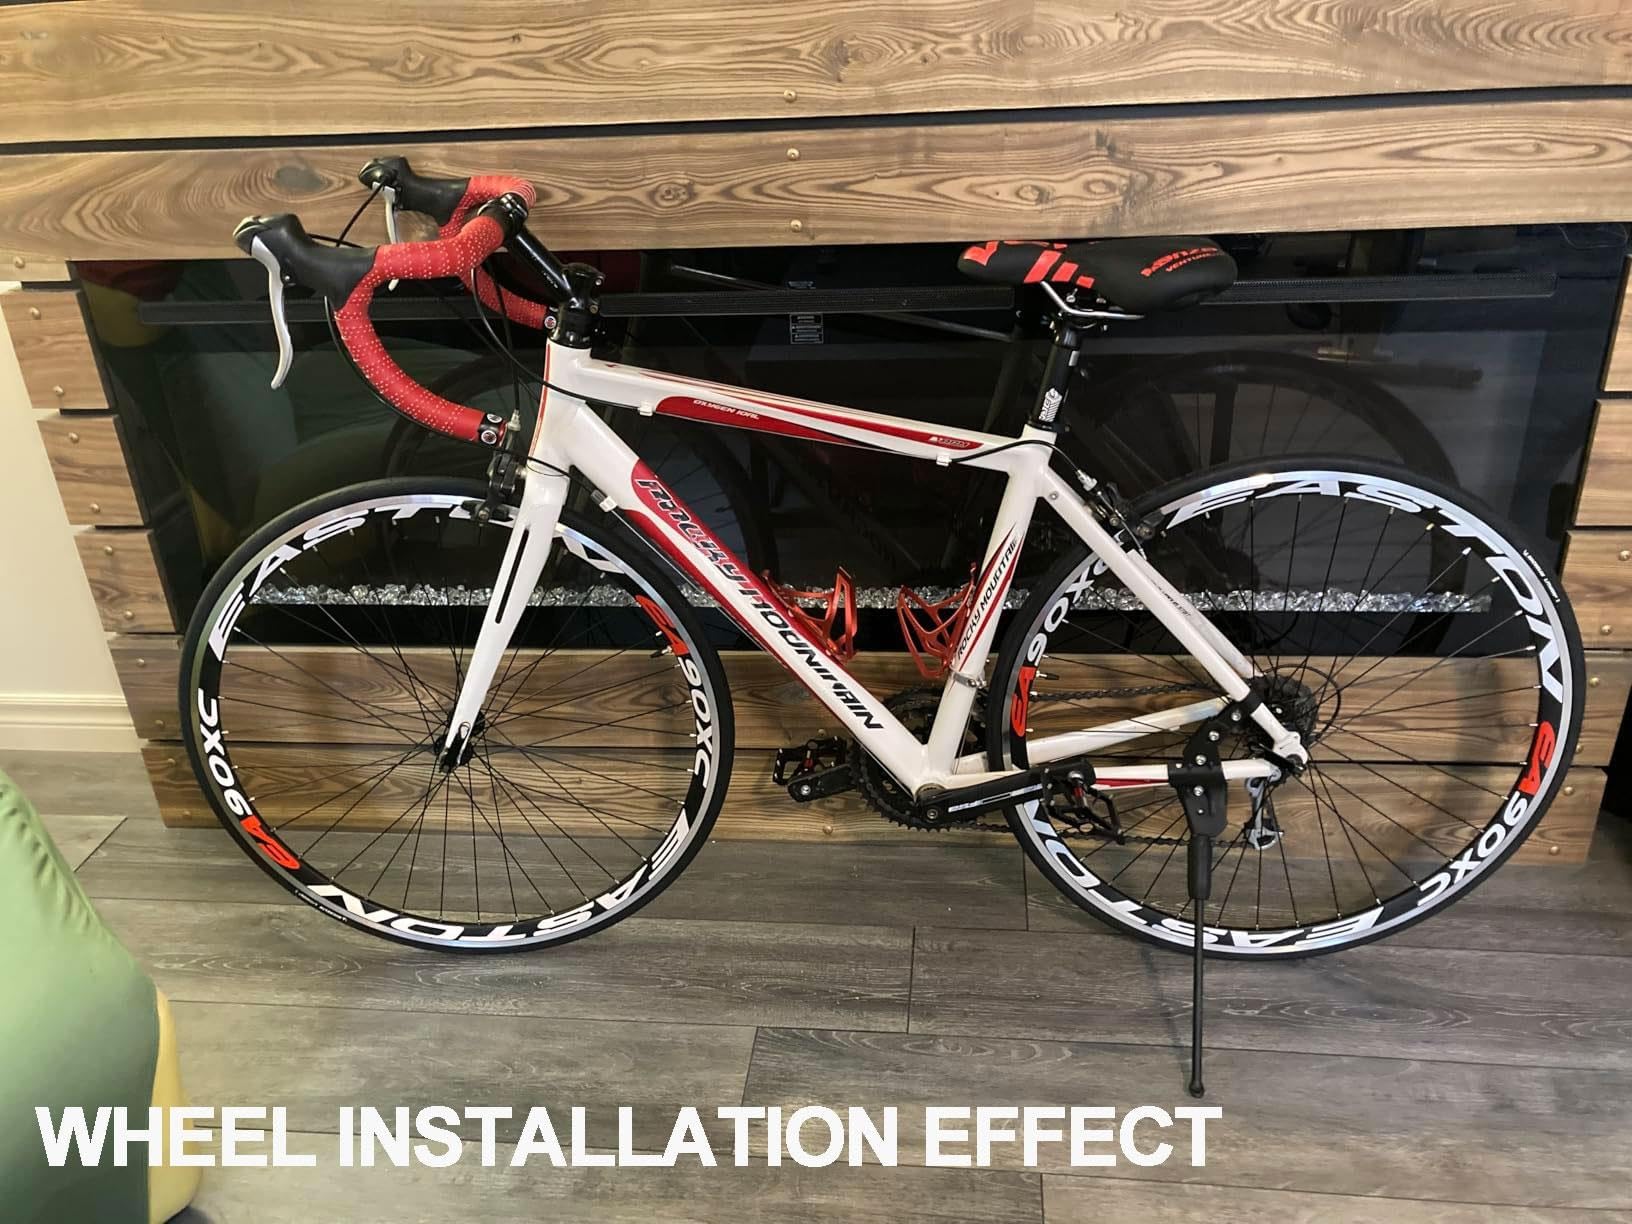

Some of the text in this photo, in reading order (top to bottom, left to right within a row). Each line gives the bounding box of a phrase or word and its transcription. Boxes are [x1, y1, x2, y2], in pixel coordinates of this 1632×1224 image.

[957, 609, 981, 660] ROCKY
[1166, 479, 1563, 704] EASTON
[307, 808, 692, 941] EASTON
